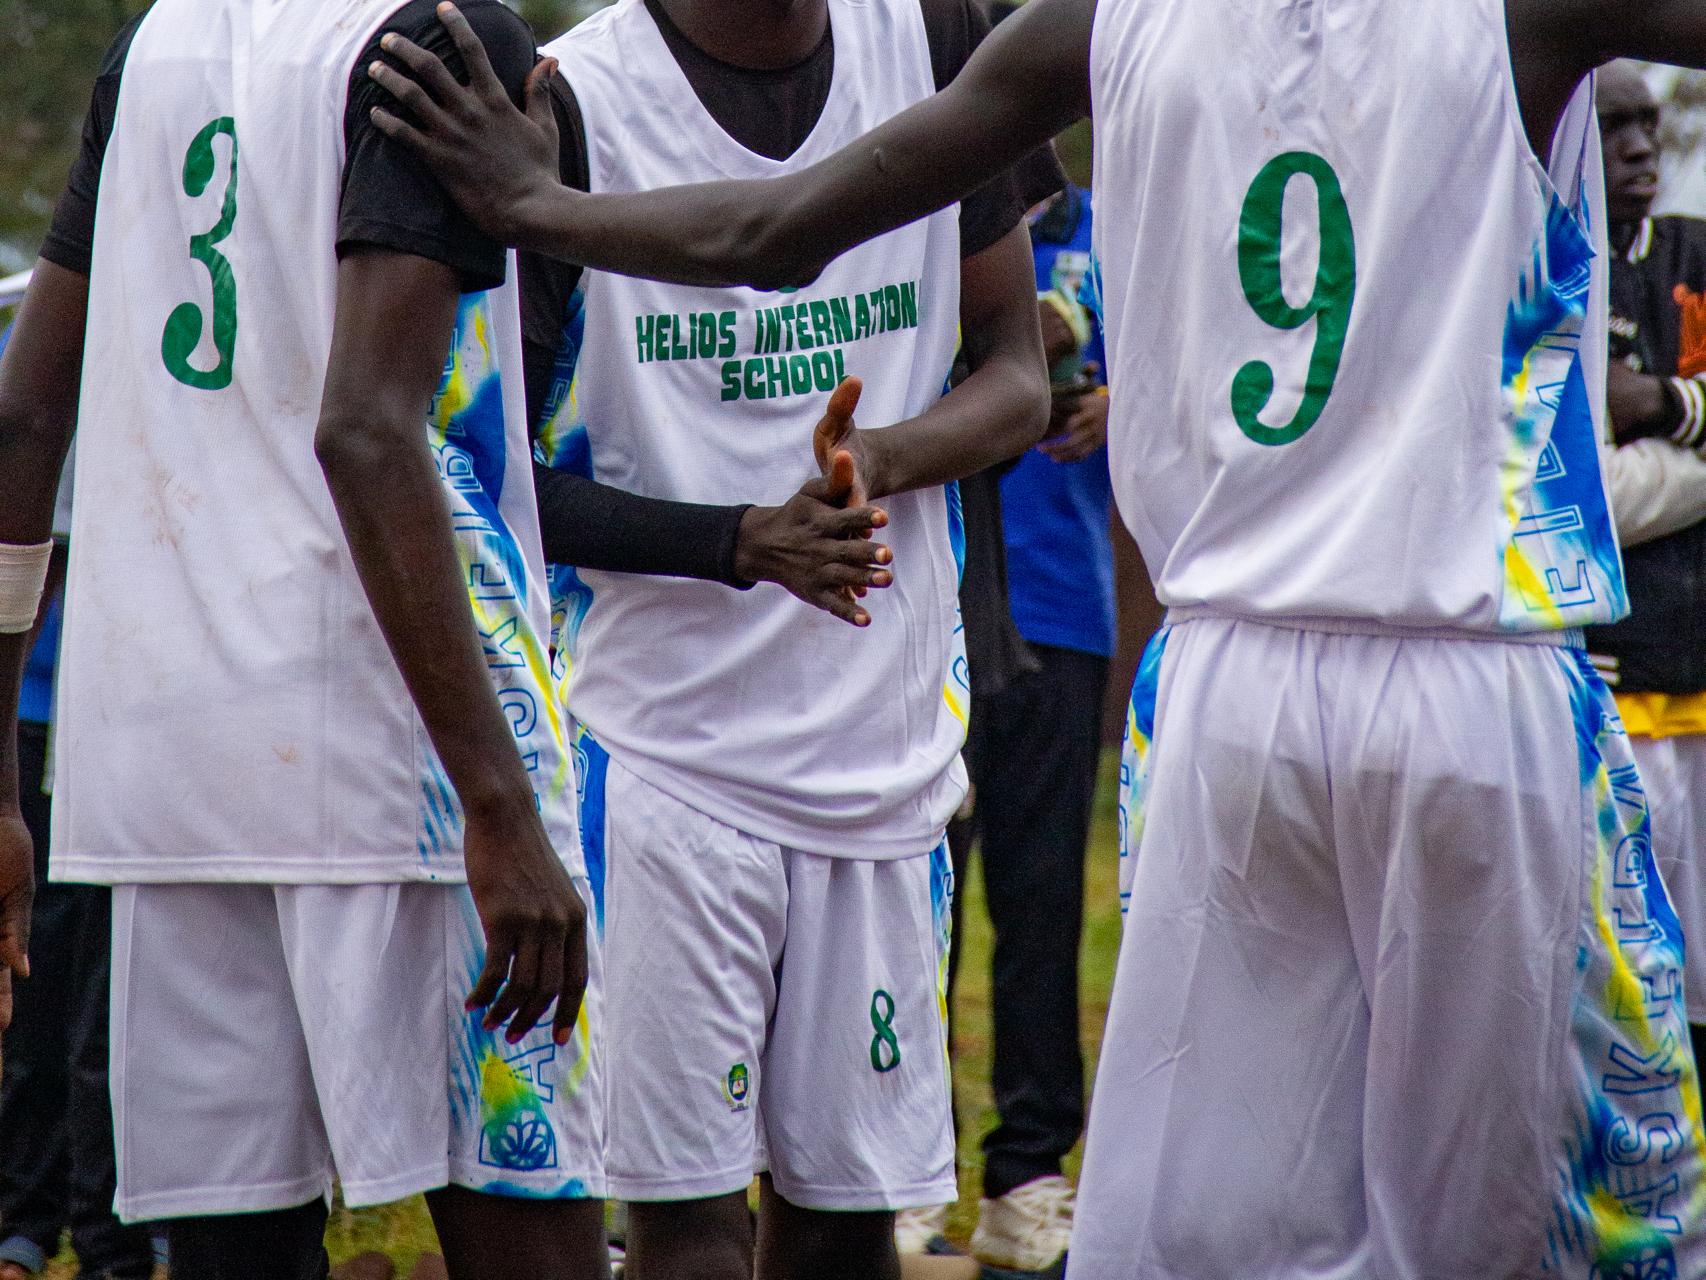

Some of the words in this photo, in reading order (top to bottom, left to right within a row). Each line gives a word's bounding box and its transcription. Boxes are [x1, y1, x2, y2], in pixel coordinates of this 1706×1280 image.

[162, 116, 238, 390] 3
[635, 311, 737, 363] HELIOS
[1231, 151, 1356, 446] 9
[720, 348, 851, 402] SCHOOL
[870, 989, 901, 1072] 8
